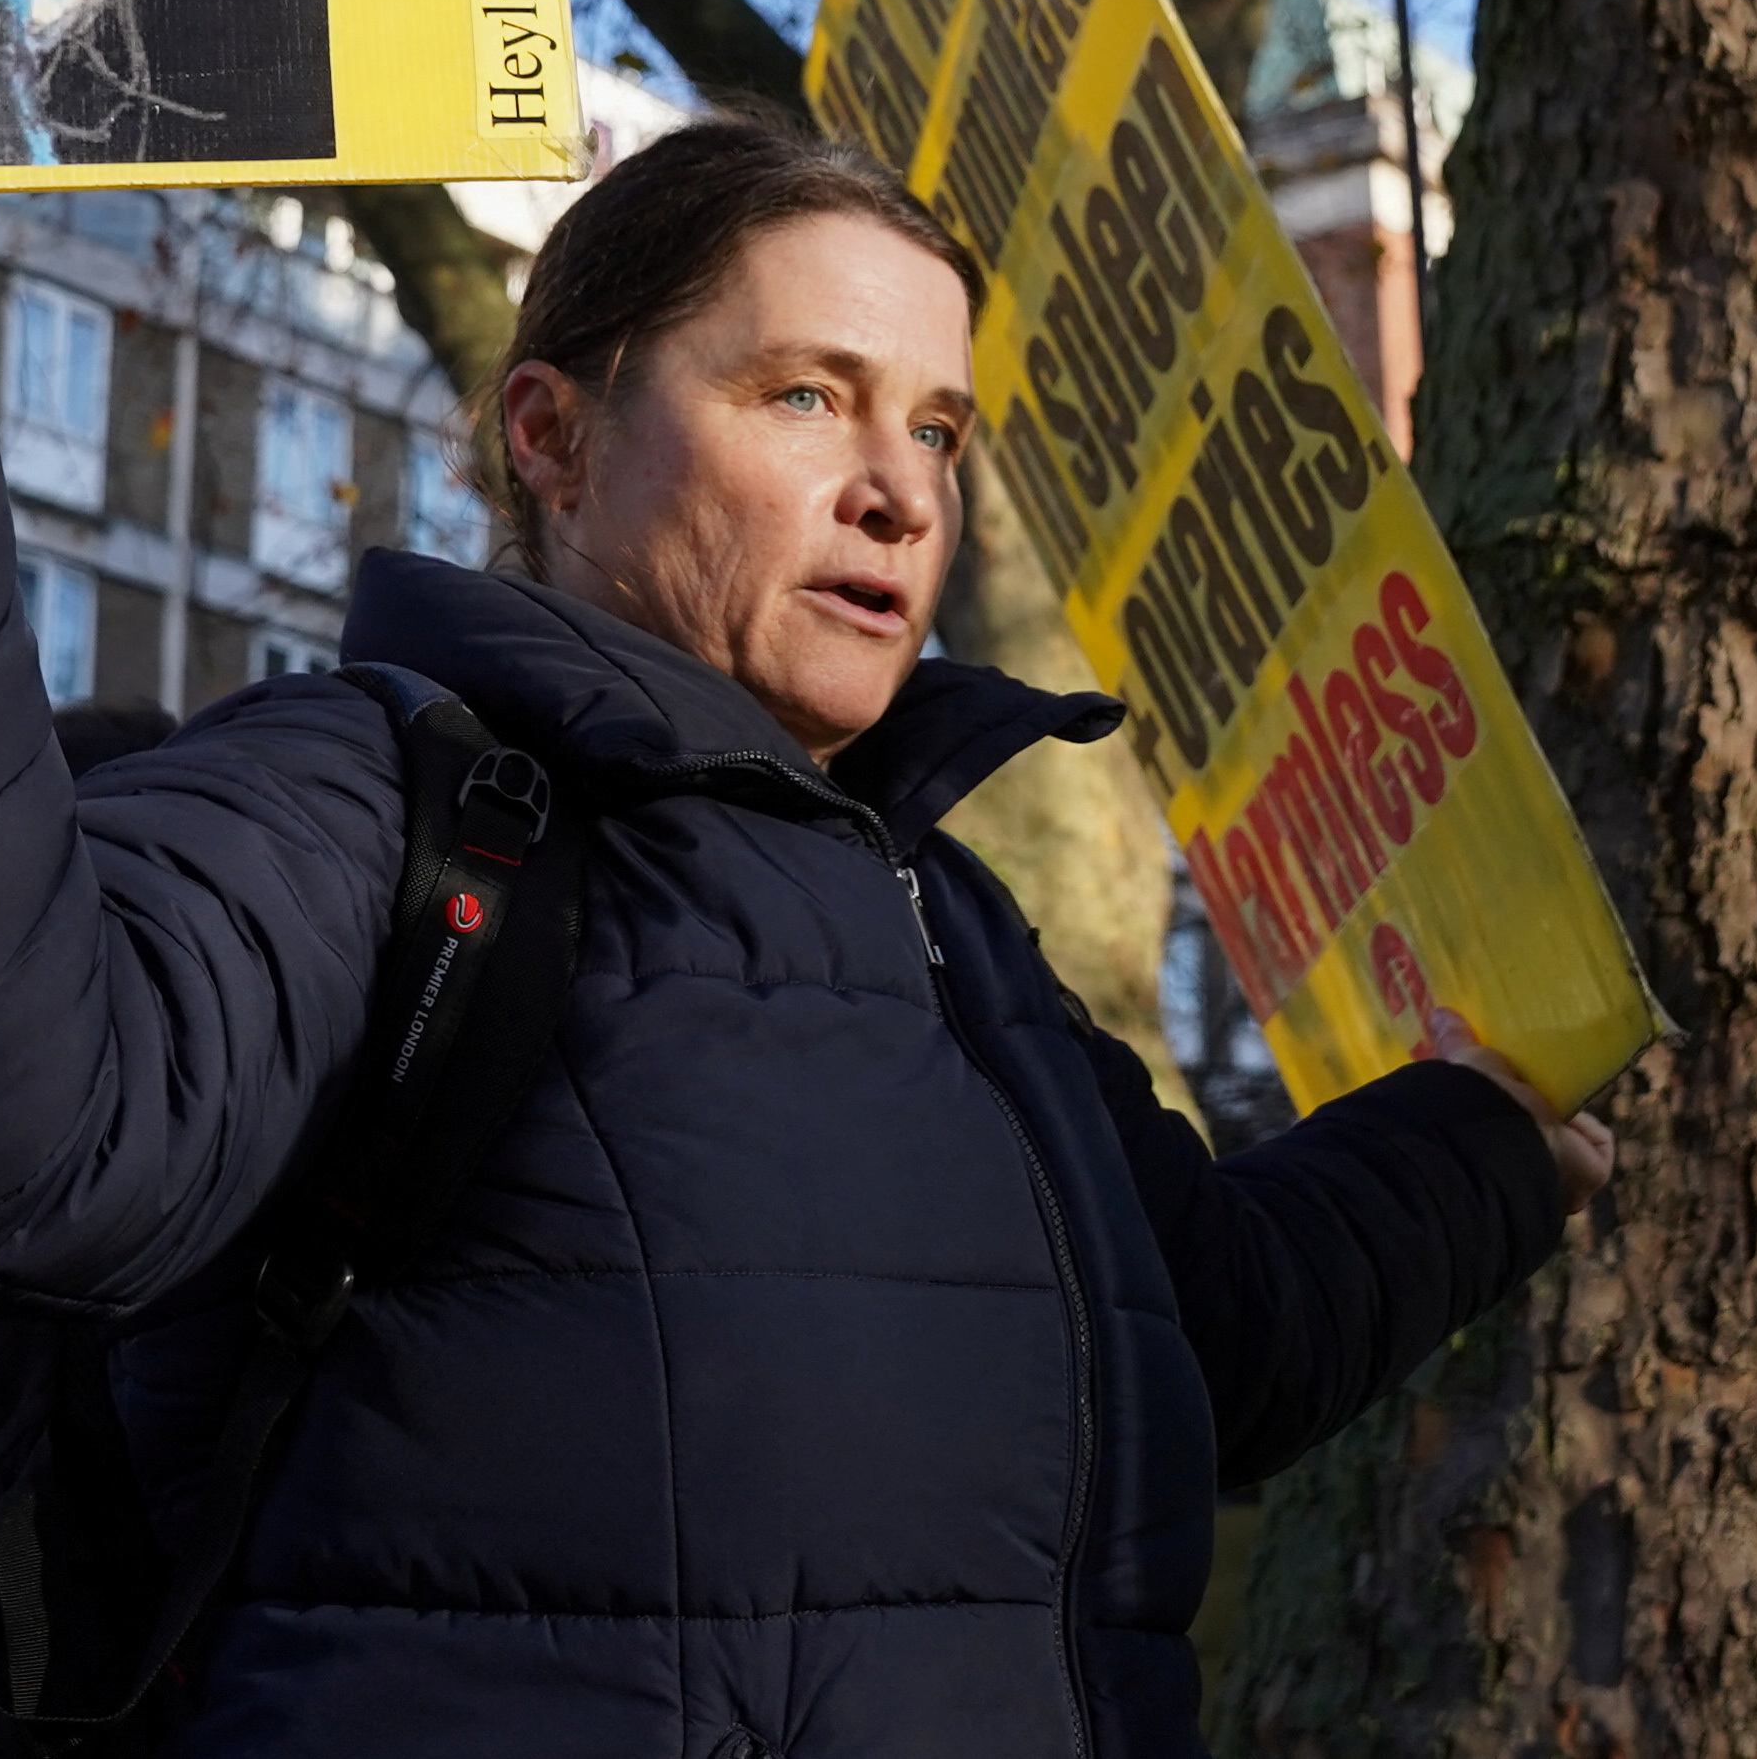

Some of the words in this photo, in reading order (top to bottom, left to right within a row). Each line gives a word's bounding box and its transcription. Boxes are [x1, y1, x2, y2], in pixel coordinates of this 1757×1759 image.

[1027, 37, 1235, 508] spleen
[420, 936, 459, 1008] PREMIER
[392, 1009, 429, 1083] LONDON
